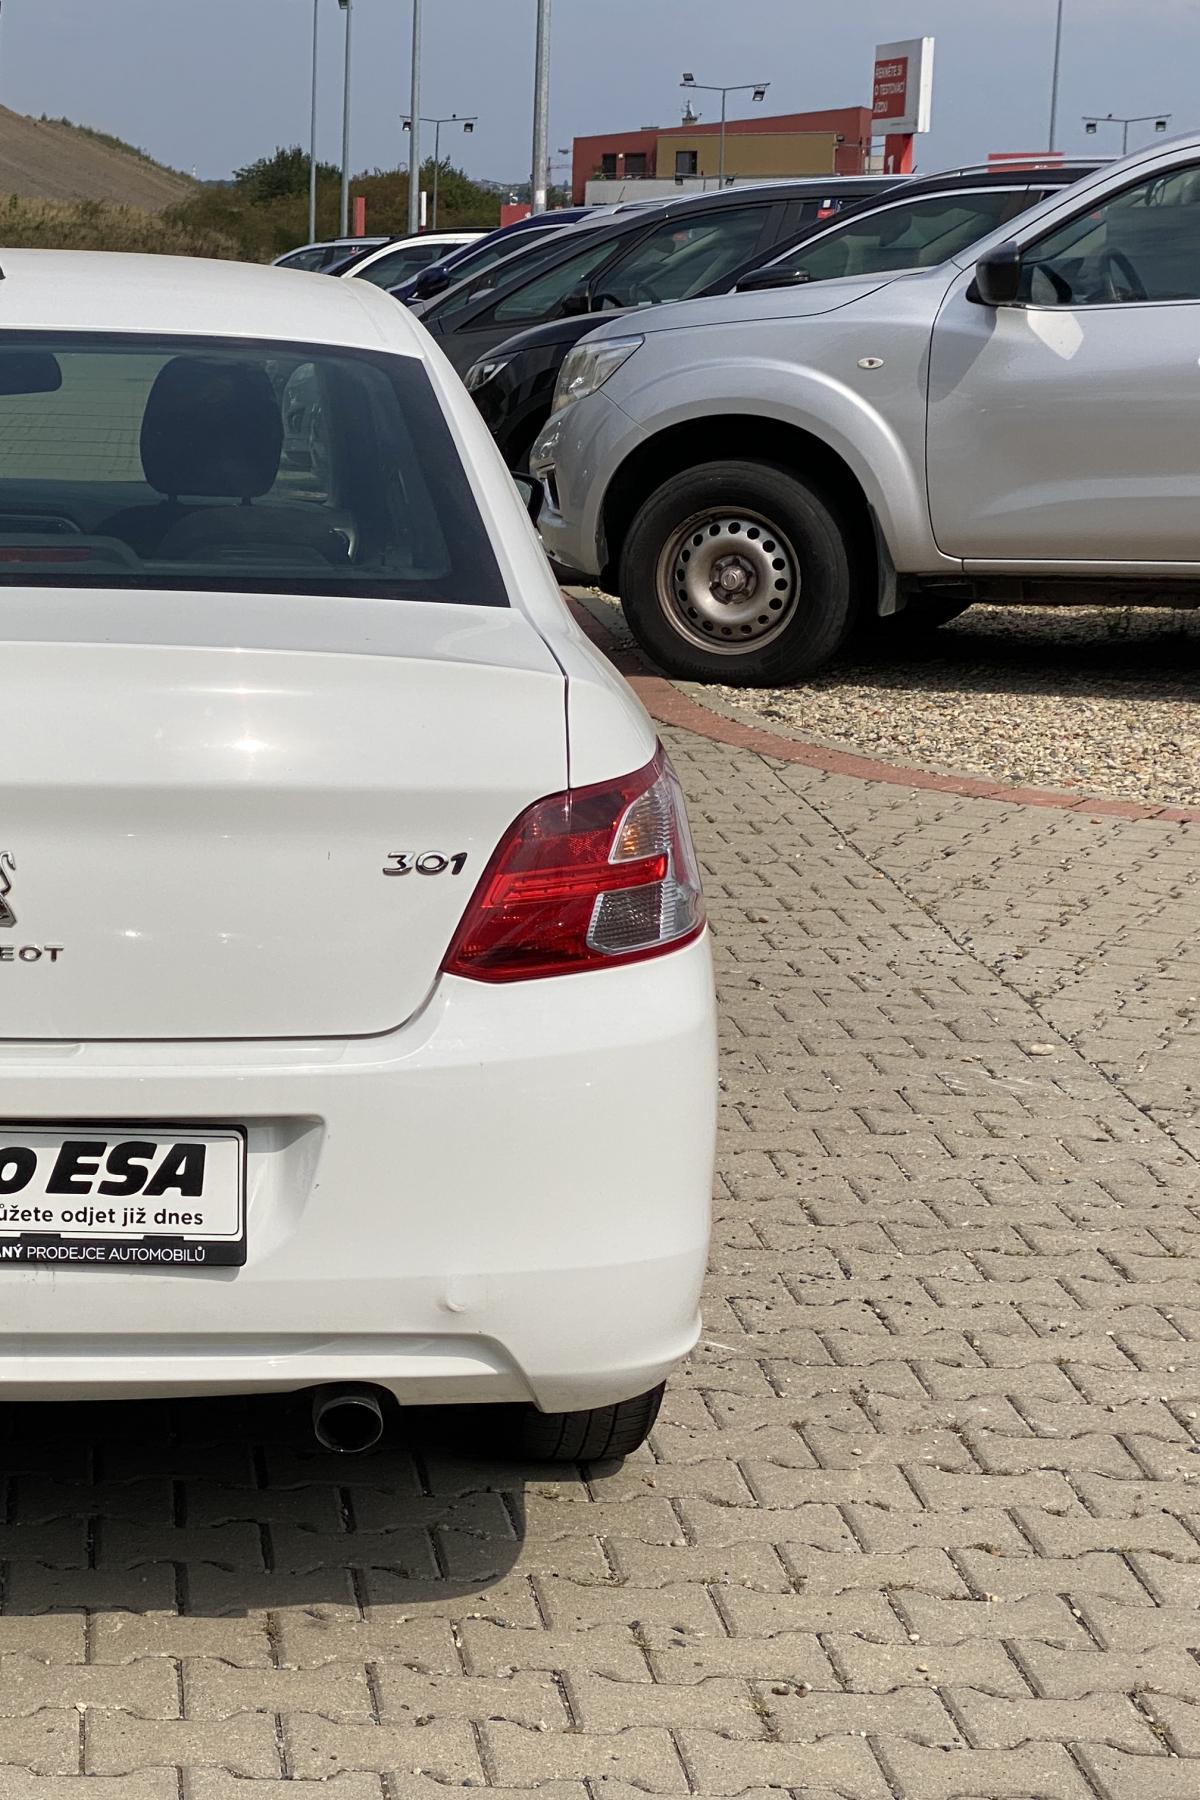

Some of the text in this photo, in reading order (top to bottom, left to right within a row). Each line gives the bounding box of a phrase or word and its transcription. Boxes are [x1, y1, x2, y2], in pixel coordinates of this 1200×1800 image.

[382, 850, 468, 876] 301
[45, 1140, 207, 1197] ESA
[61, 1206, 115, 1226] odjet
[122, 1204, 146, 1226] již
[154, 1208, 203, 1225] dnes
[27, 1246, 105, 1260] PRODEJCE
[108, 1245, 205, 1262] AUTOMOBILŮ
